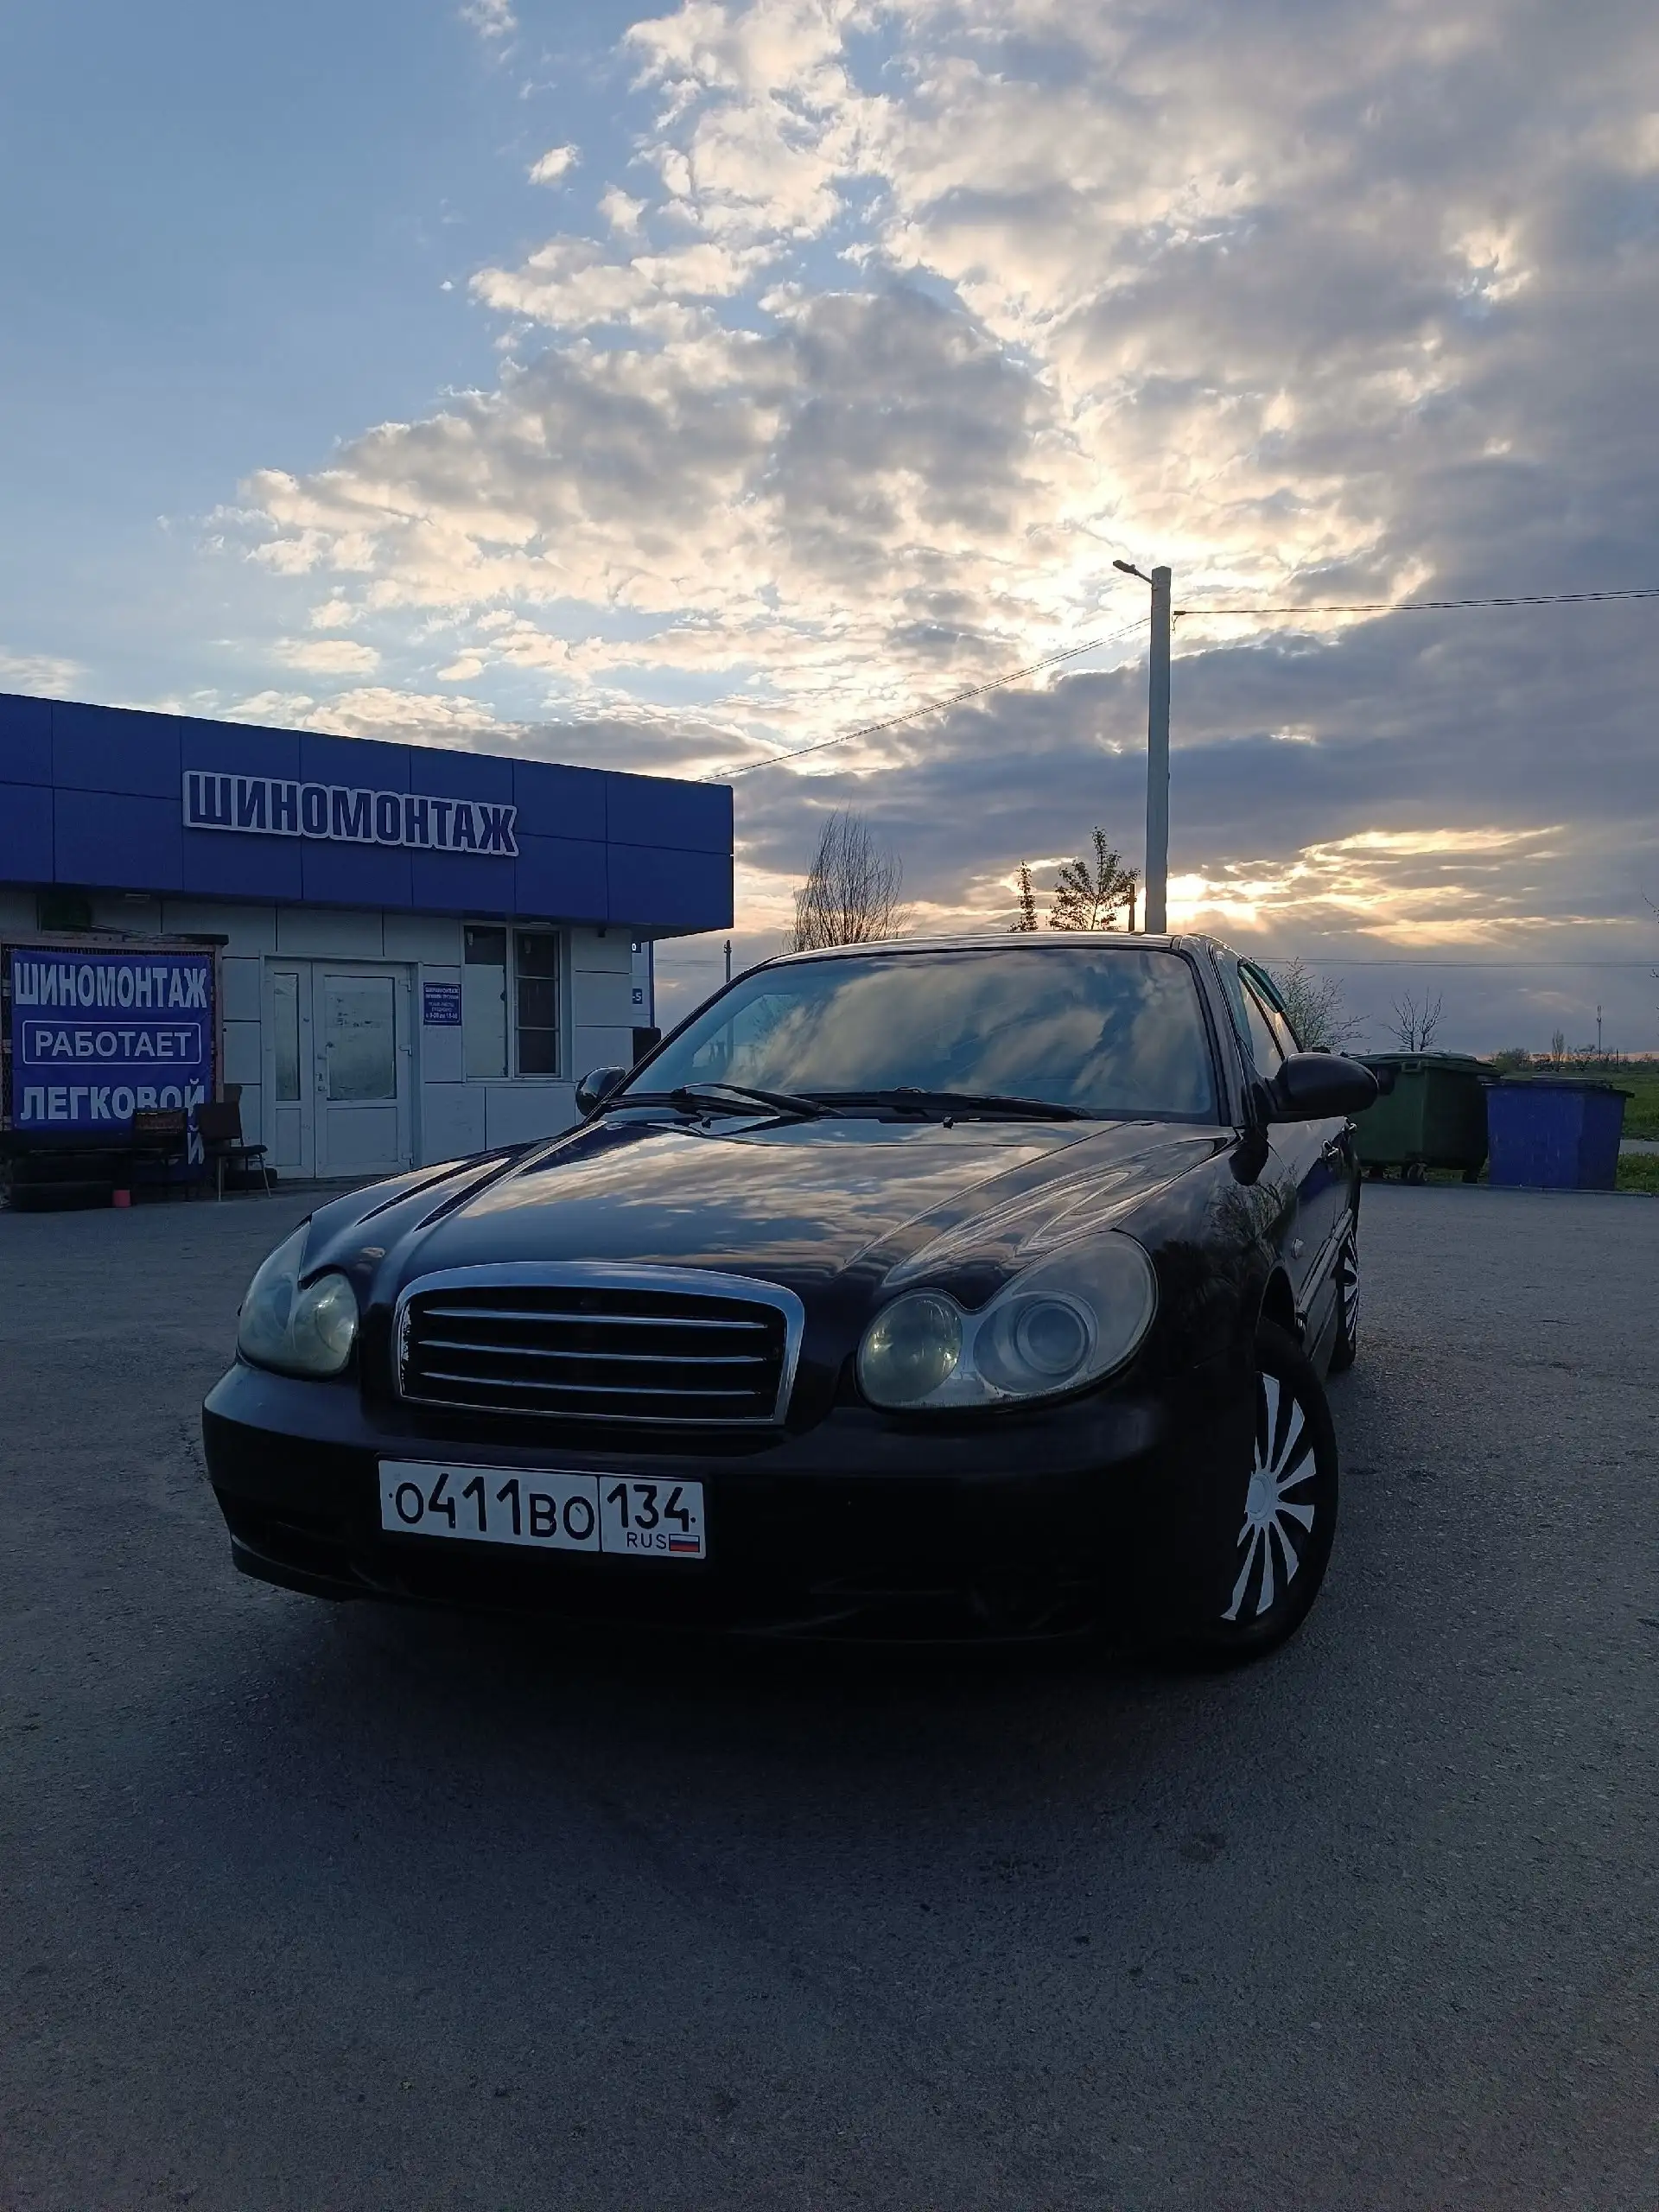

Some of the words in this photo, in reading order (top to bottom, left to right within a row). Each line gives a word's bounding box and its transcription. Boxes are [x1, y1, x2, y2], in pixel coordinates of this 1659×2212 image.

[188, 773, 517, 854] ШИНОМОНТАЖ
[14, 962, 207, 1008] ШИНОМОНТАЖ
[35, 1030, 192, 1057] РАБОТАЕТ
[21, 1077, 205, 1121] ЛЕГКОВОЙ
[607, 1483, 690, 1532] 134
[626, 1532, 667, 1550] RUS
